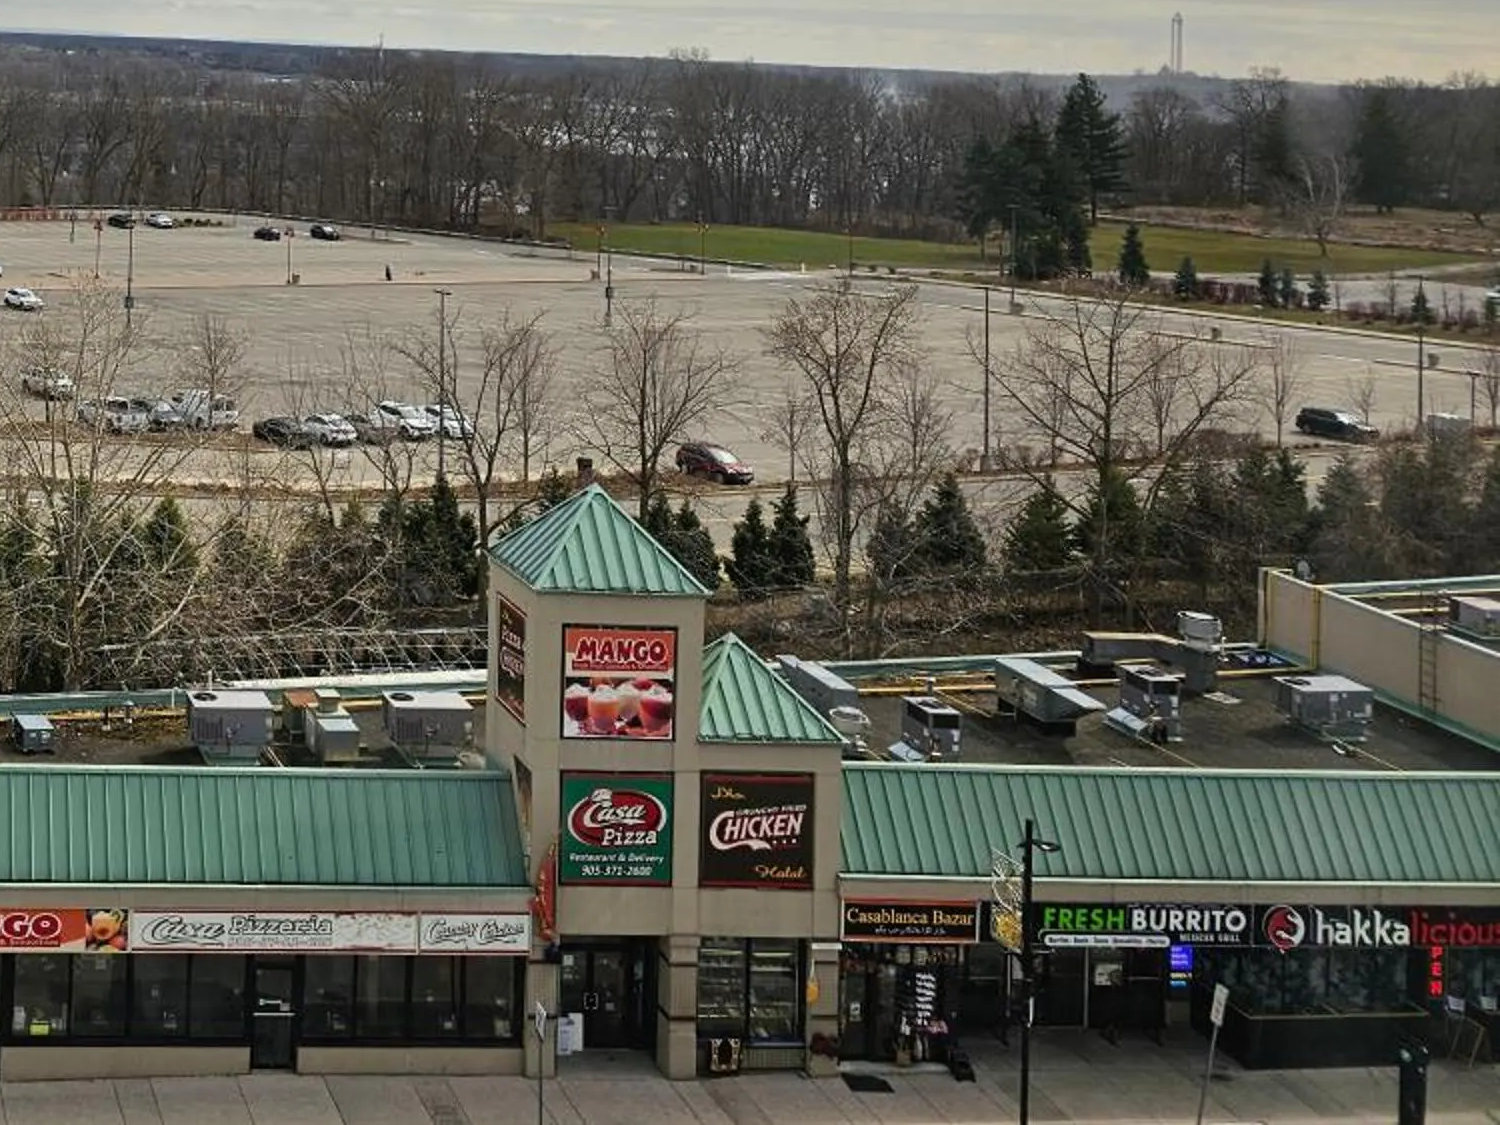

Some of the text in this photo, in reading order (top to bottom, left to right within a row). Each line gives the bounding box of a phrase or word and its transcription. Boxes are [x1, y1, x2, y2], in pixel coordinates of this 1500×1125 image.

[575, 637, 669, 664] MANGO
[583, 802, 647, 828] Casa
[601, 826, 657, 846] Pizza
[709, 810, 804, 851] CHICKEN
[228, 915, 333, 935] Pizzeria
[846, 907, 974, 925] Casablanca Bazar
[1044, 907, 1246, 932] FRESH BURRITO
[1430, 945, 1444, 996] PEN
